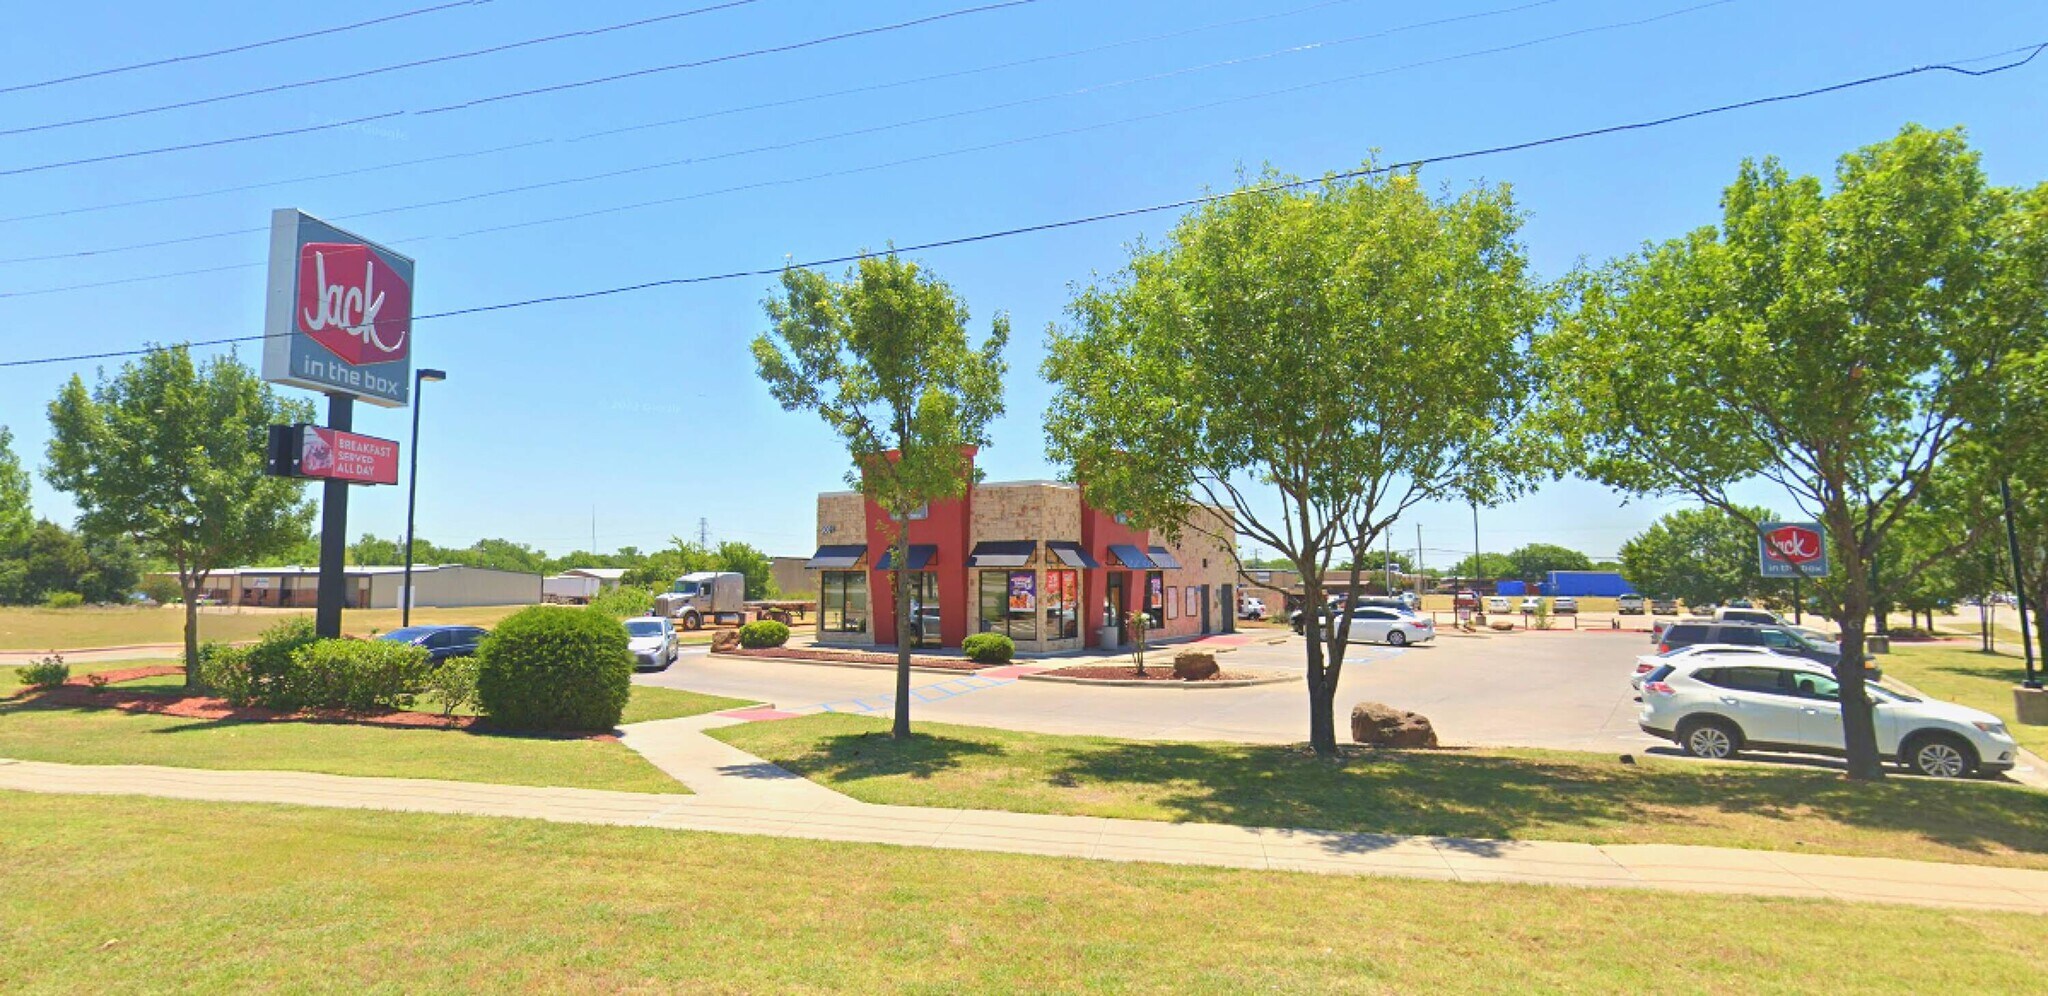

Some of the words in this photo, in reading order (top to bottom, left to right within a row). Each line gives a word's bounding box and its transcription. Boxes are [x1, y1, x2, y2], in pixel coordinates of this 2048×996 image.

[303, 250, 406, 352] Jack
[304, 354, 324, 377] in
[329, 361, 361, 386] the
[365, 370, 398, 395] box
[338, 450, 374, 464] SERVED
[339, 438, 391, 458] BREAKFAST
[336, 462, 354, 474] ALL
[356, 464, 375, 476] DAY
